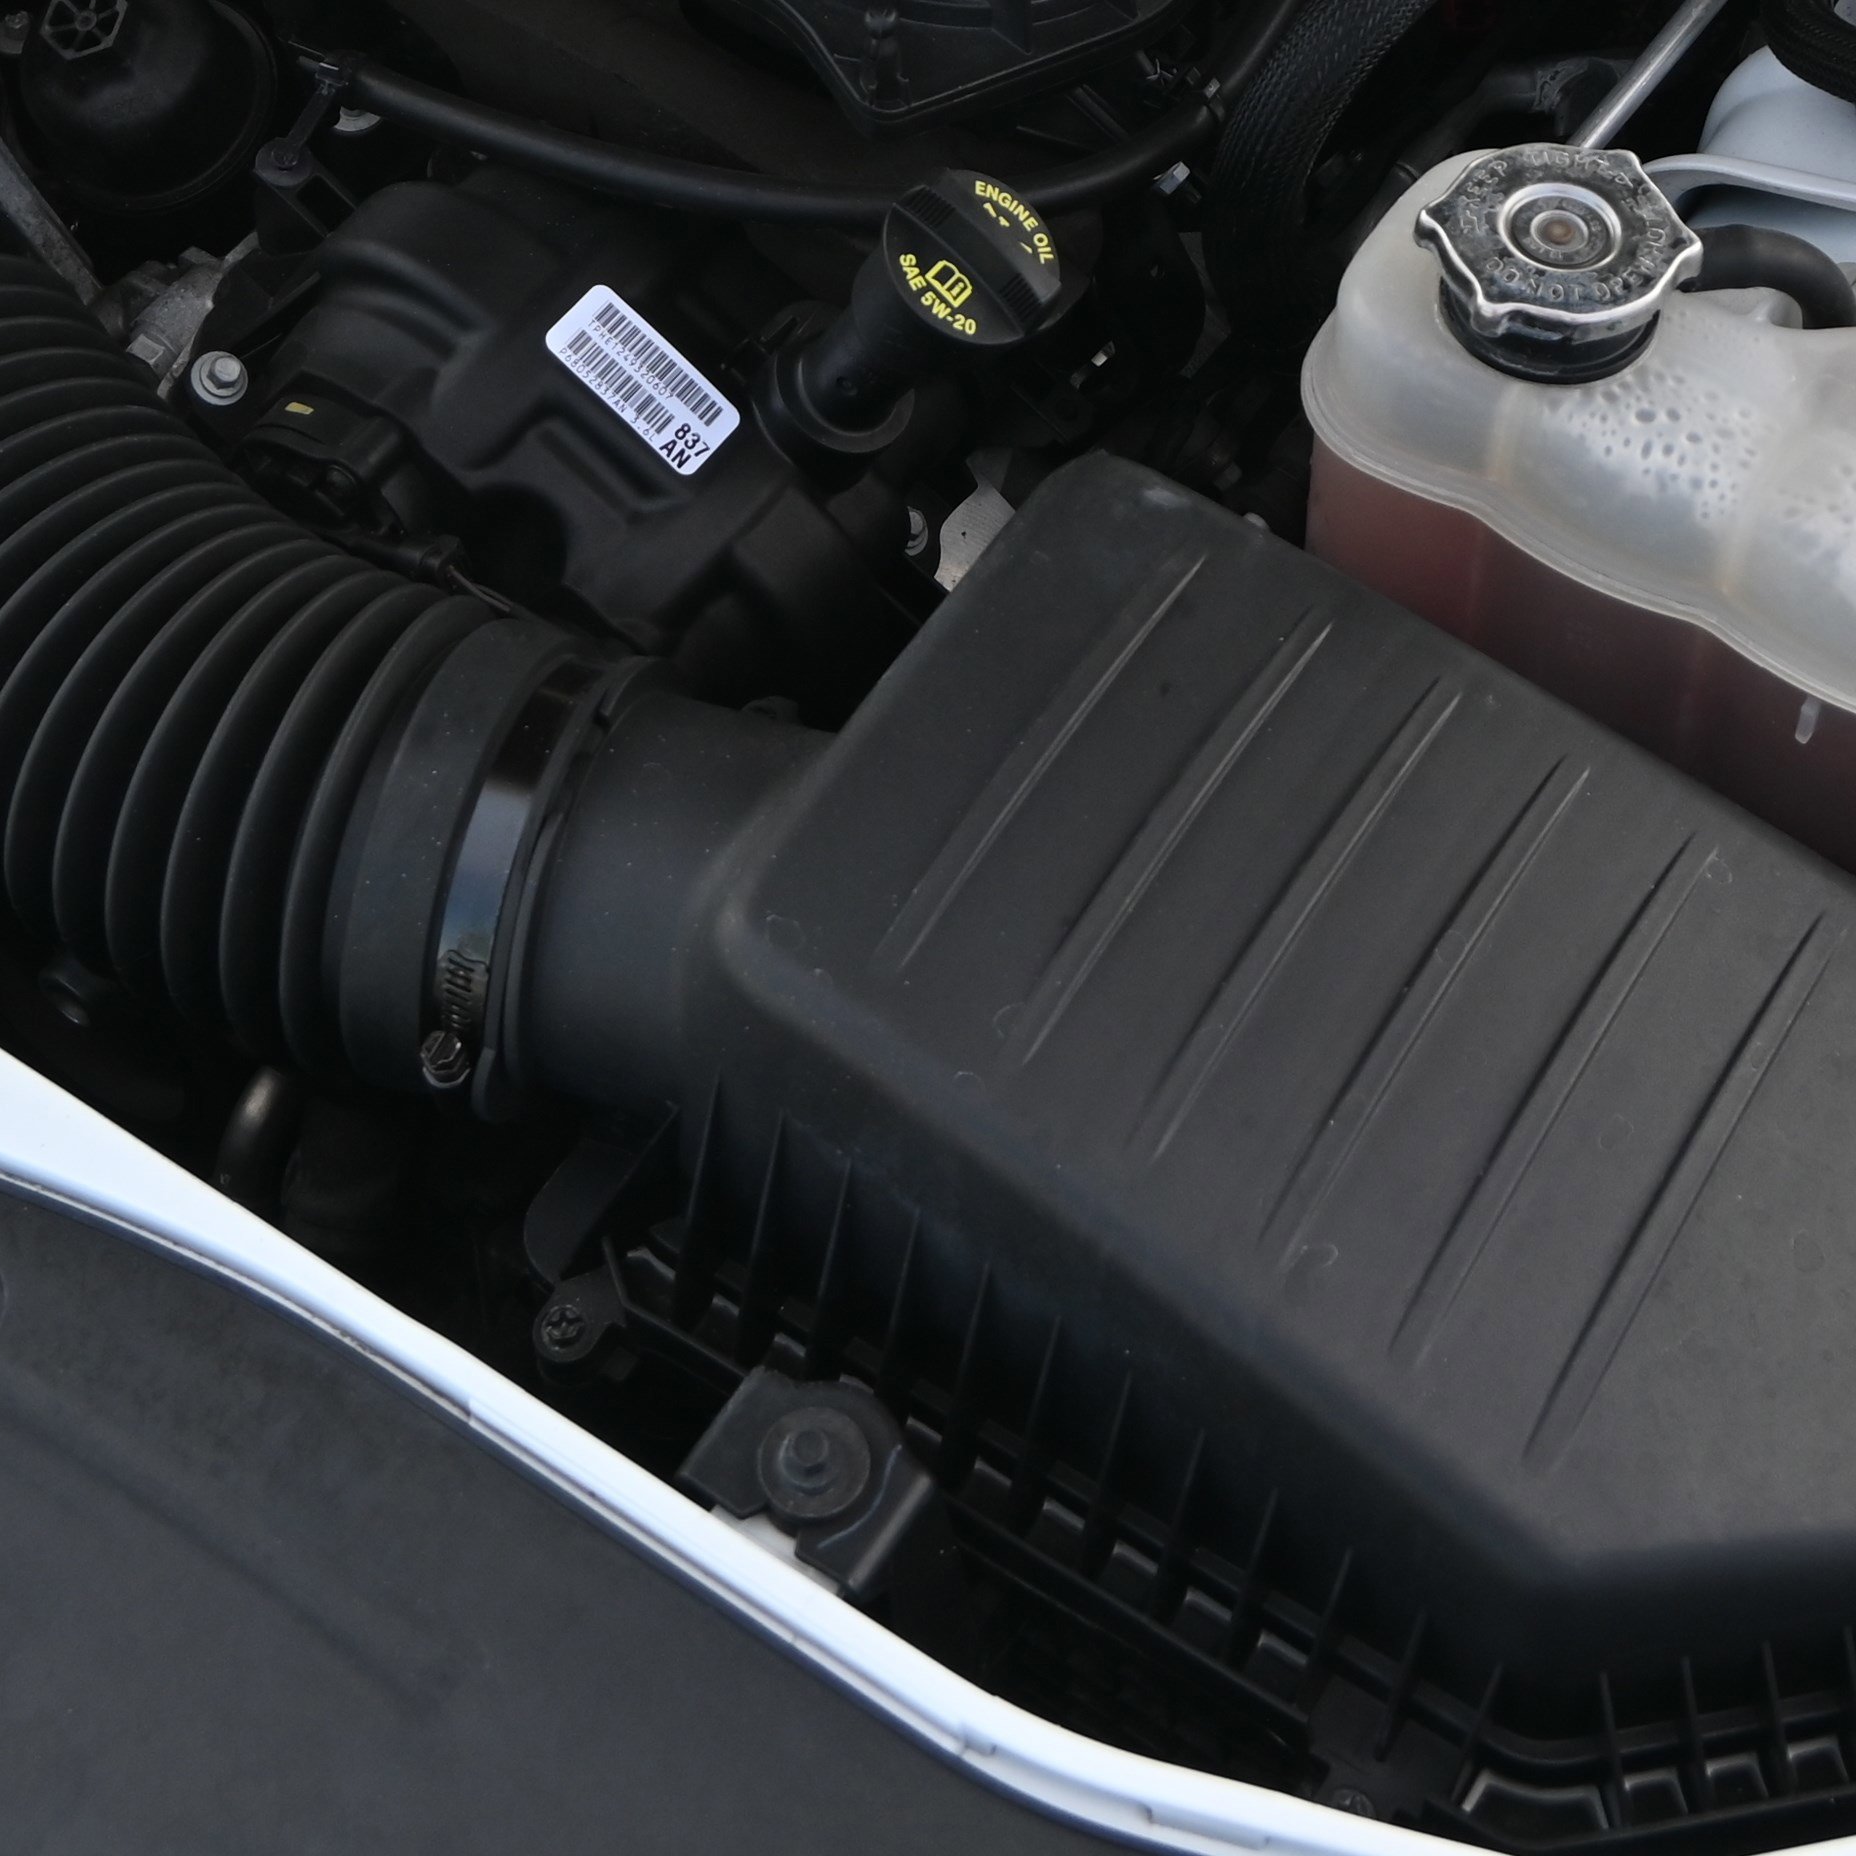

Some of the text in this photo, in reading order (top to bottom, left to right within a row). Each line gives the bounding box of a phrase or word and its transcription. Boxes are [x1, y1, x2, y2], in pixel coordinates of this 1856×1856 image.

[975, 180, 1054, 264] ENGINE OIL
[899, 253, 976, 335] SAE 5W-20
[1485, 256, 1520, 283] DO
[1527, 276, 1583, 303] NOT
[1594, 254, 1656, 303] OPEN
[559, 347, 658, 442] P68052837AN 3.6L
[587, 319, 674, 400] TPHE1249320607
[659, 439, 692, 469] AN
[674, 422, 711, 458] 837
